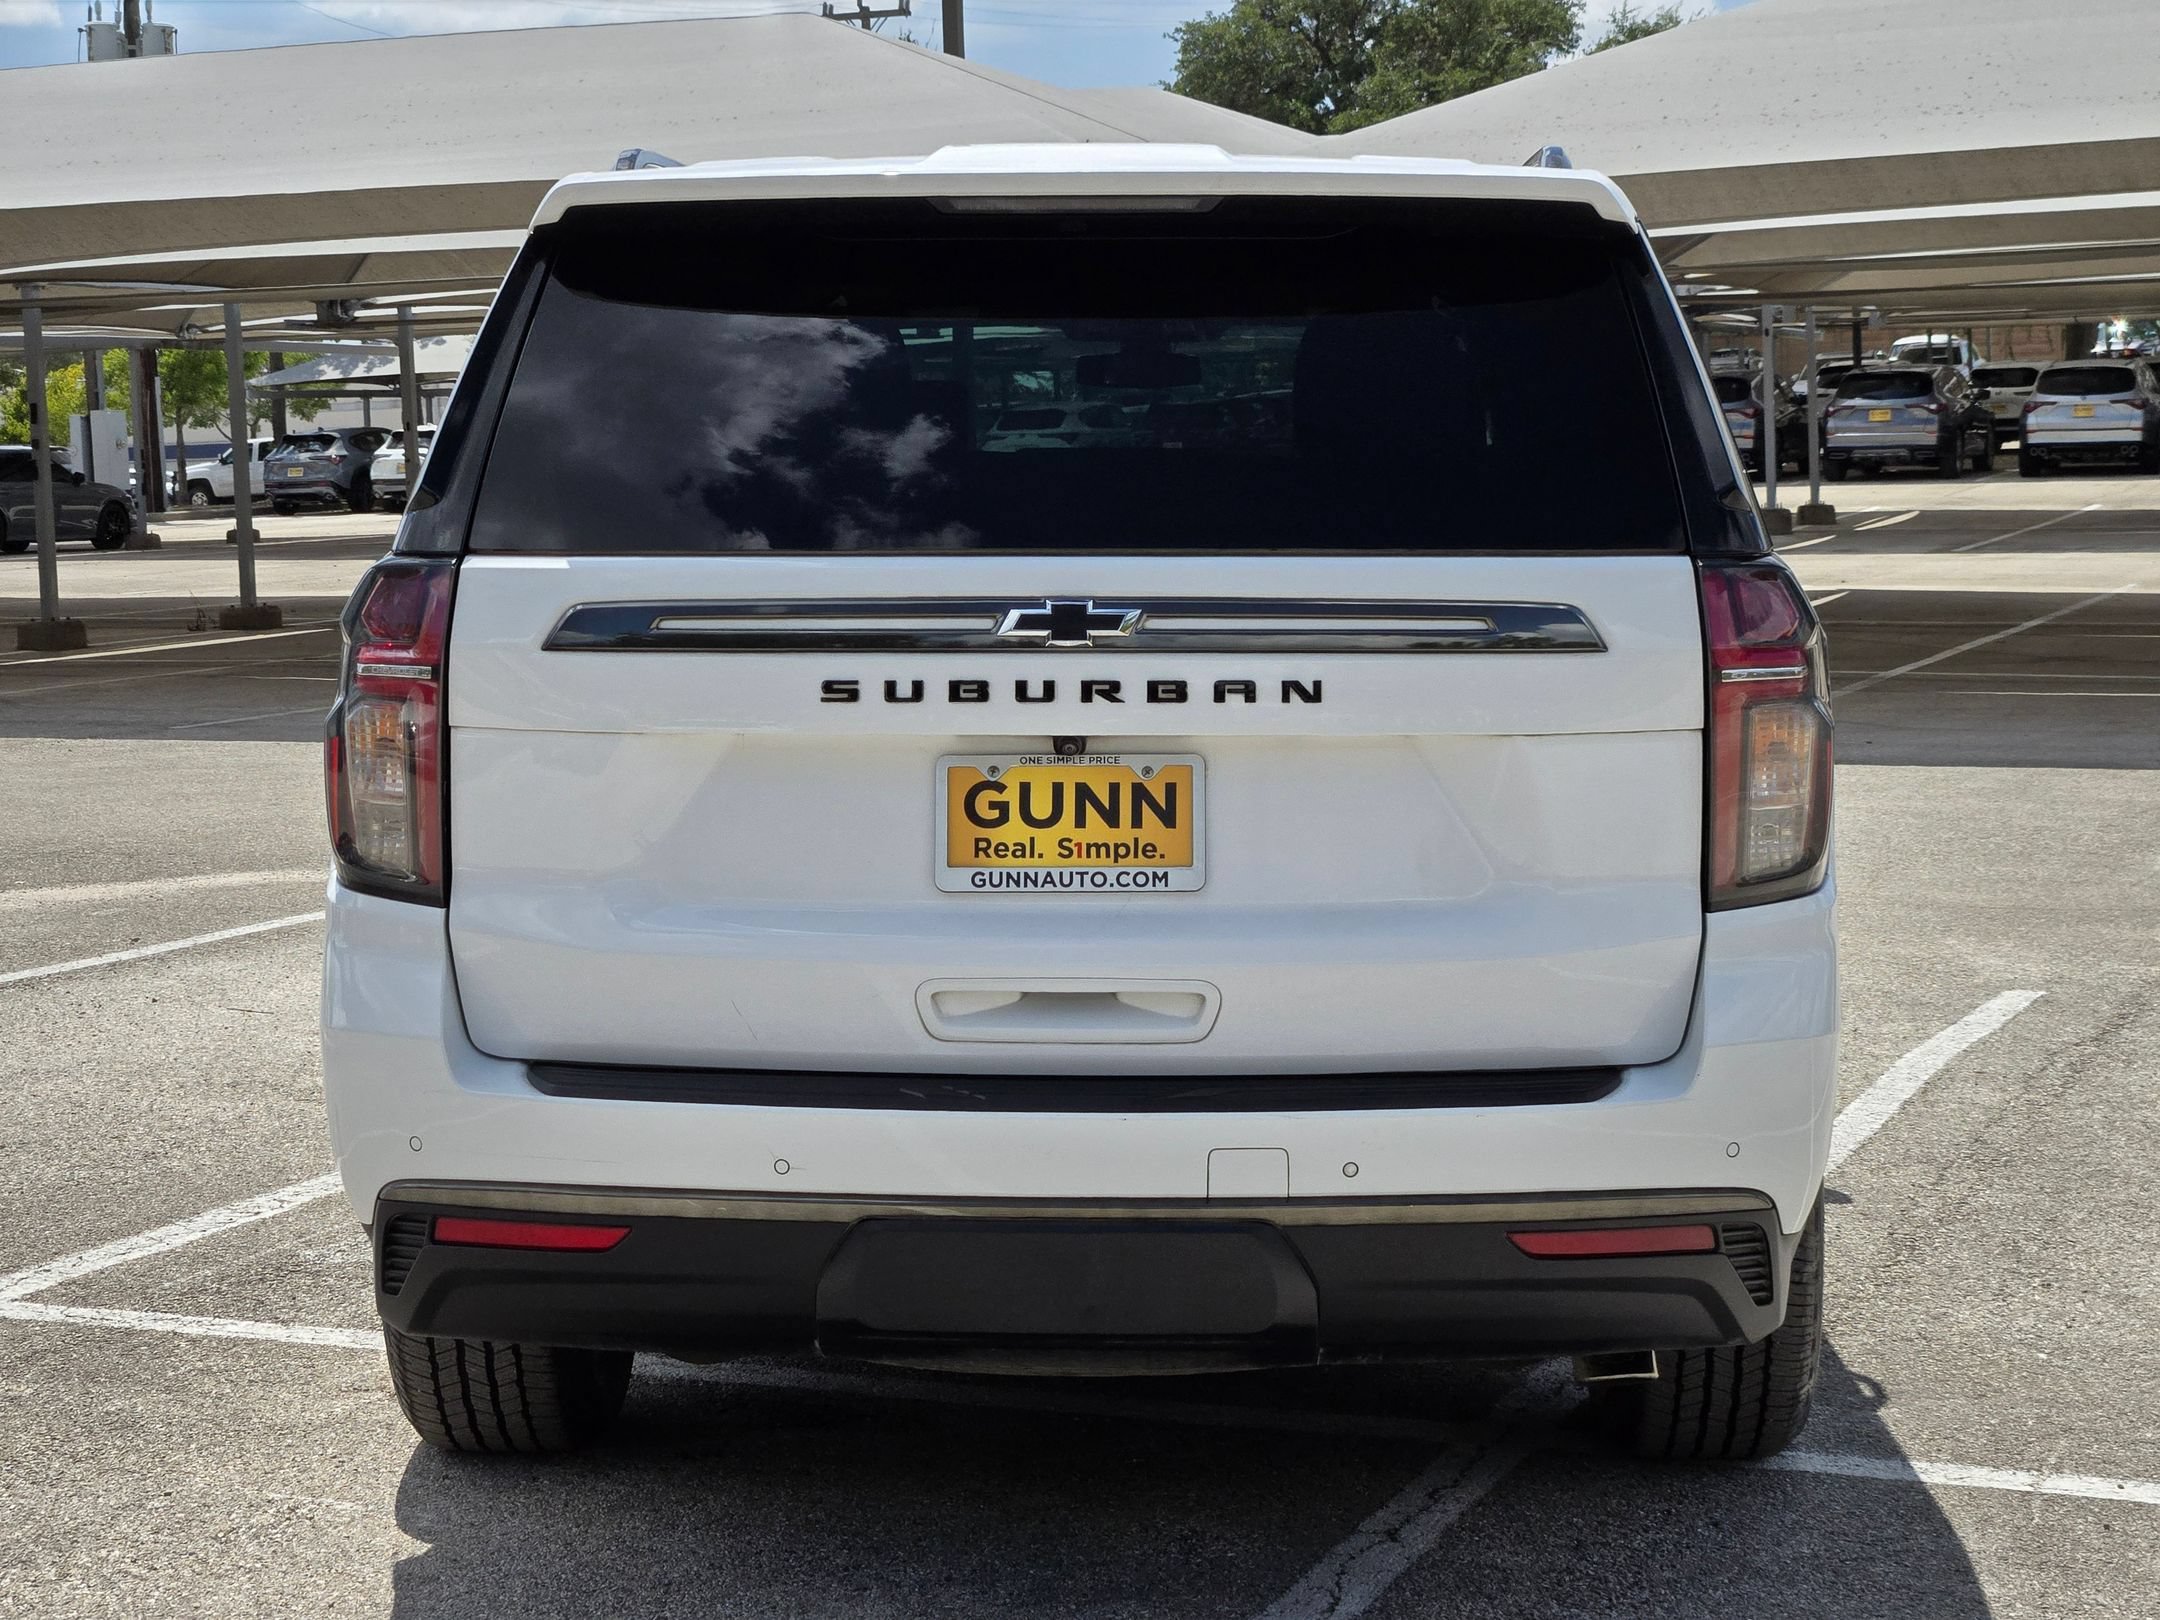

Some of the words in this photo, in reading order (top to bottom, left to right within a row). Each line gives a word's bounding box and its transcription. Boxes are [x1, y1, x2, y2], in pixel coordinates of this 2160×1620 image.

[821, 680, 1322, 703] SUBURBAN
[1020, 756, 1043, 765] ONE
[1046, 756, 1085, 765] SIMPLE
[1089, 756, 1121, 764] PRICE
[963, 780, 1176, 829] GUNN
[974, 837, 1044, 859] Real.
[970, 871, 1169, 888] GUNNAUTO.COM
